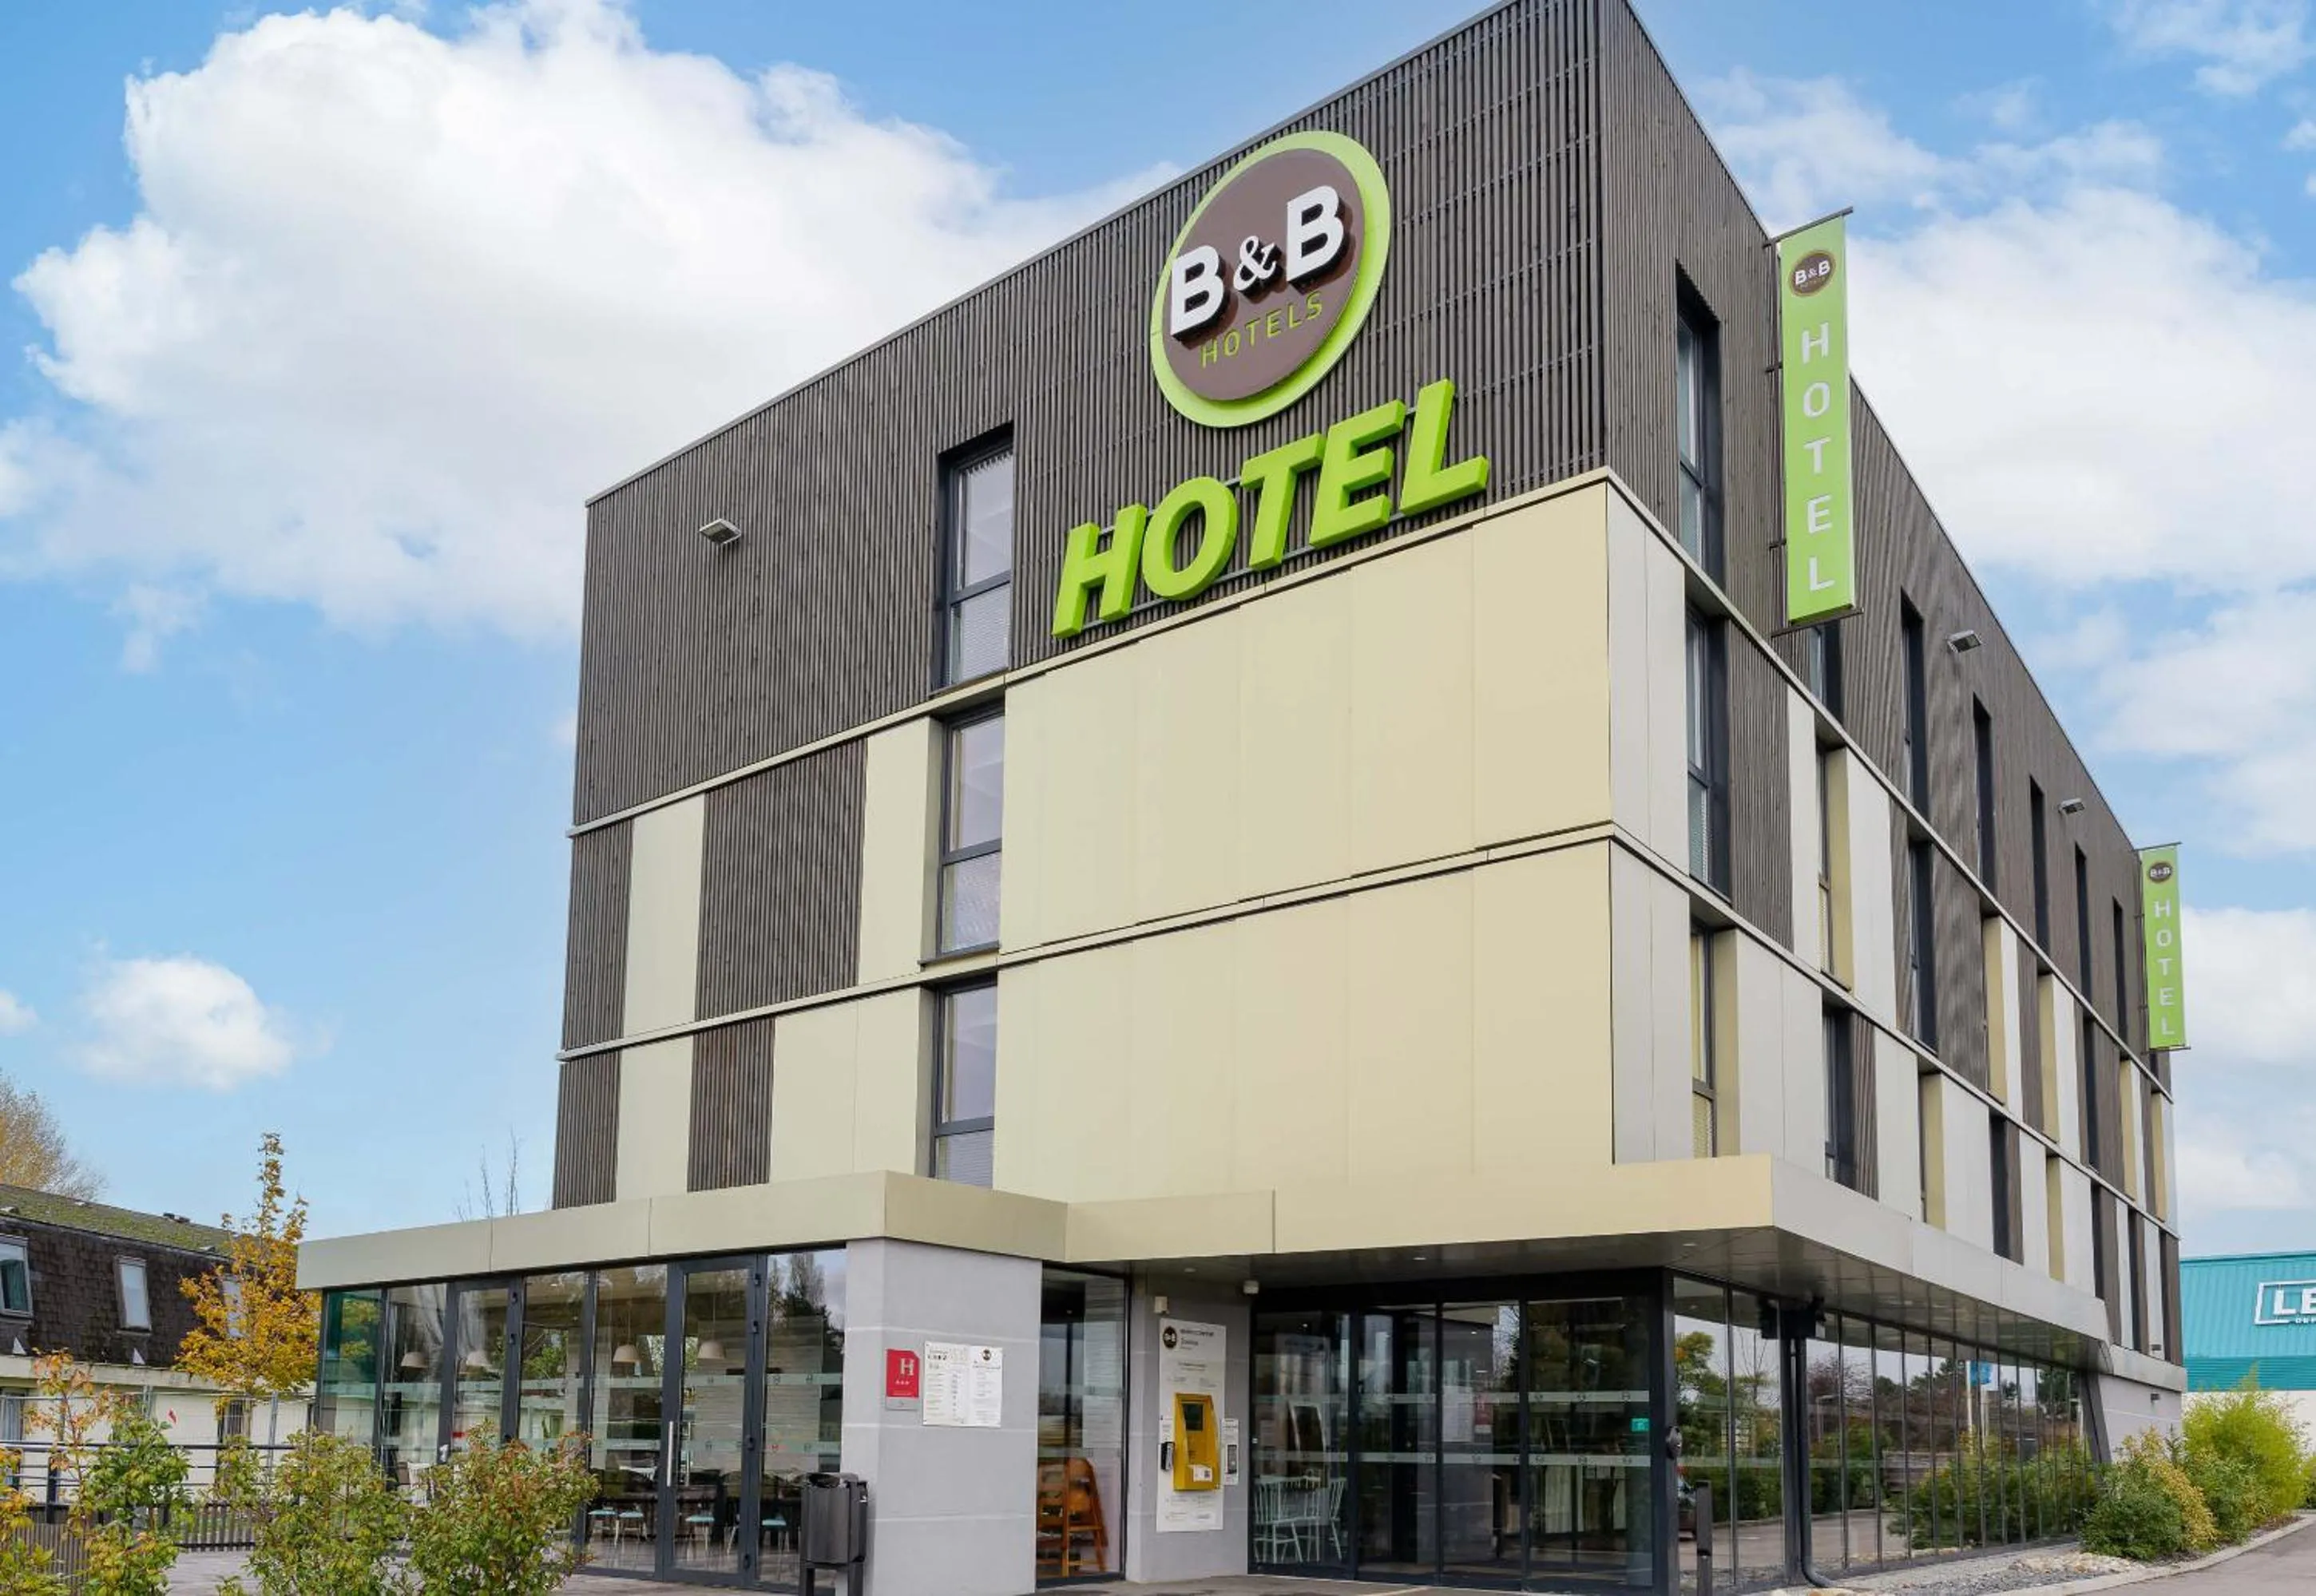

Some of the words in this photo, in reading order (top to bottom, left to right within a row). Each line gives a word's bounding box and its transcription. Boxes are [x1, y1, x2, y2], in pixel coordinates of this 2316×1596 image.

[1170, 185, 1350, 339] B&B
[1201, 291, 1324, 369] HOTELS
[1795, 259, 1830, 285] B&B
[1052, 378, 1489, 640] HOTEL
[1801, 322, 1835, 591] HOTEL
[2154, 898, 2175, 1036] HOTEL
